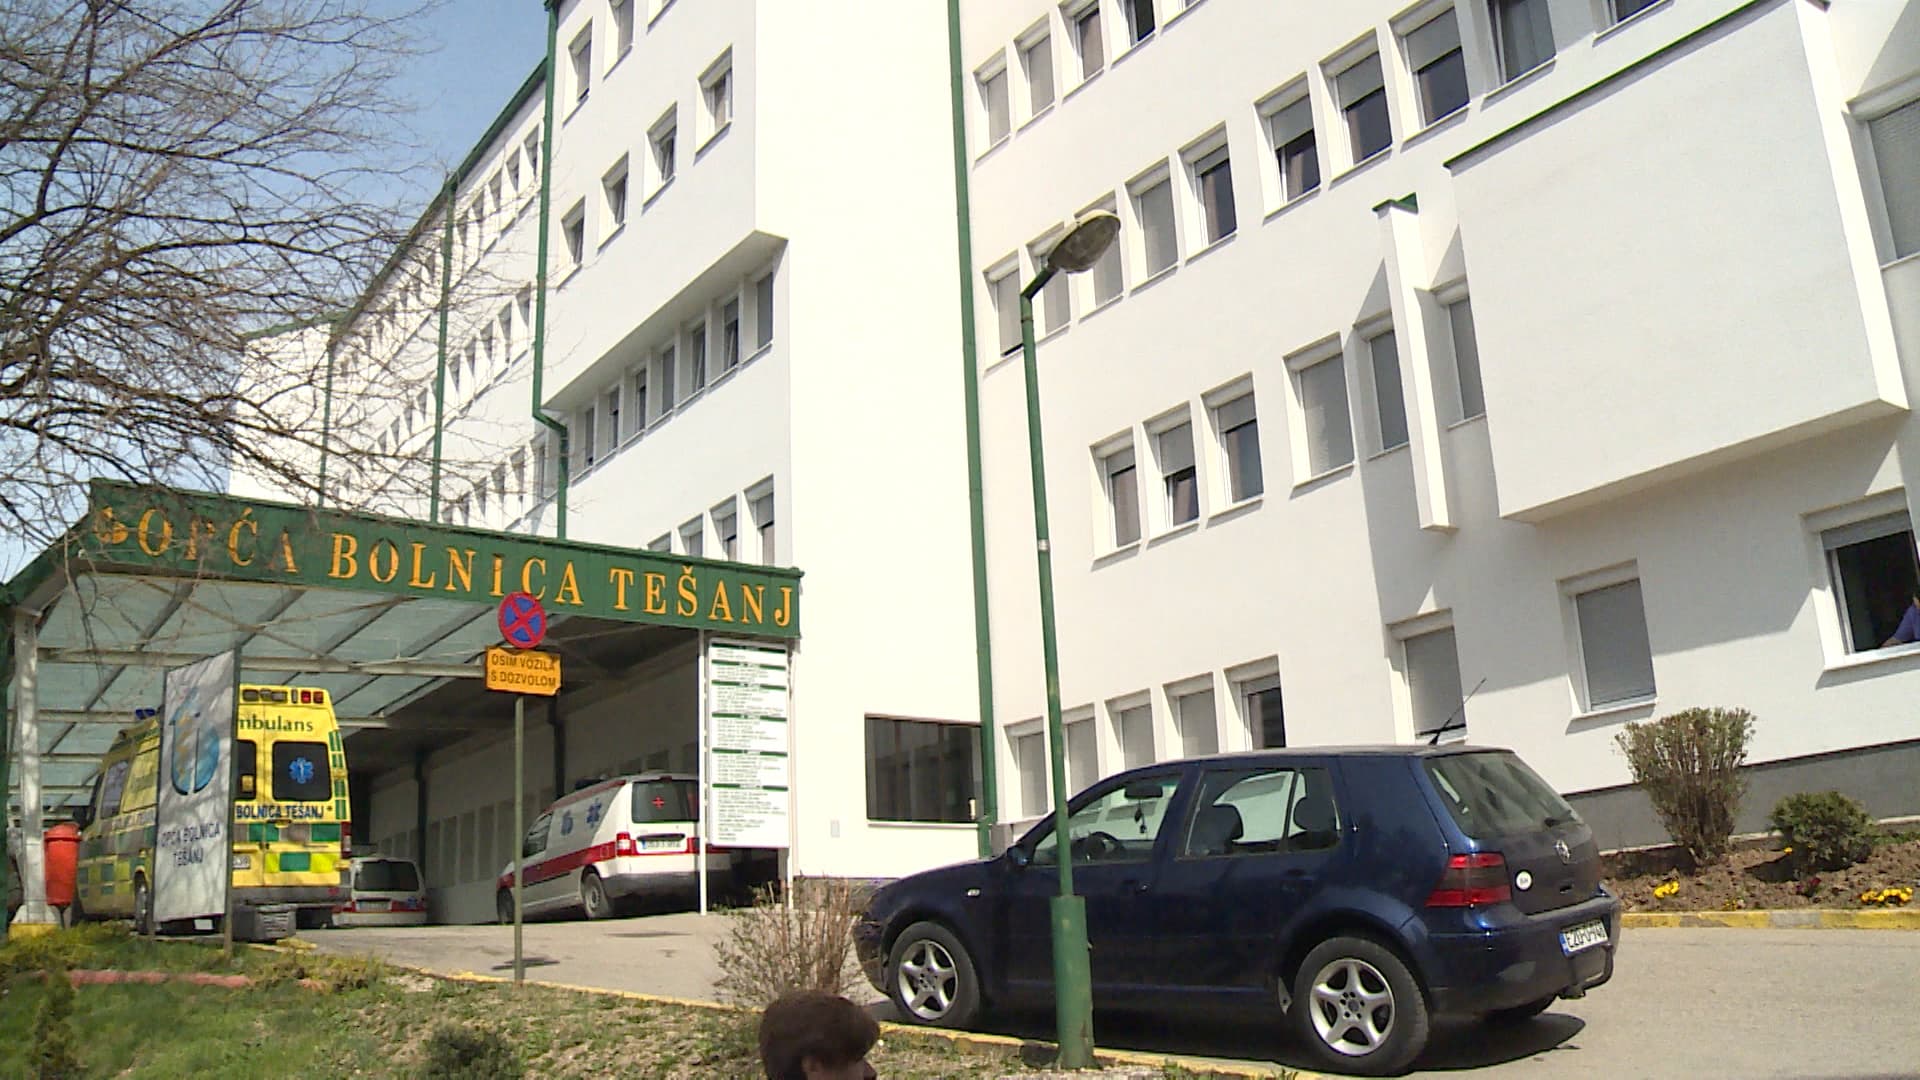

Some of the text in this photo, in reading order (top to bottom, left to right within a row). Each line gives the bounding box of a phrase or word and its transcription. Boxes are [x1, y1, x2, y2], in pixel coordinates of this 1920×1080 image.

[328, 532, 584, 606] BOLNICA
[608, 564, 793, 628] TEŠANJ
[491, 654, 556, 672] OSIM VOZILA
[491, 670, 556, 686] S DOZVOLOM
[237, 714, 314, 733] mbulans
[235, 804, 282, 819] BOLNICA
